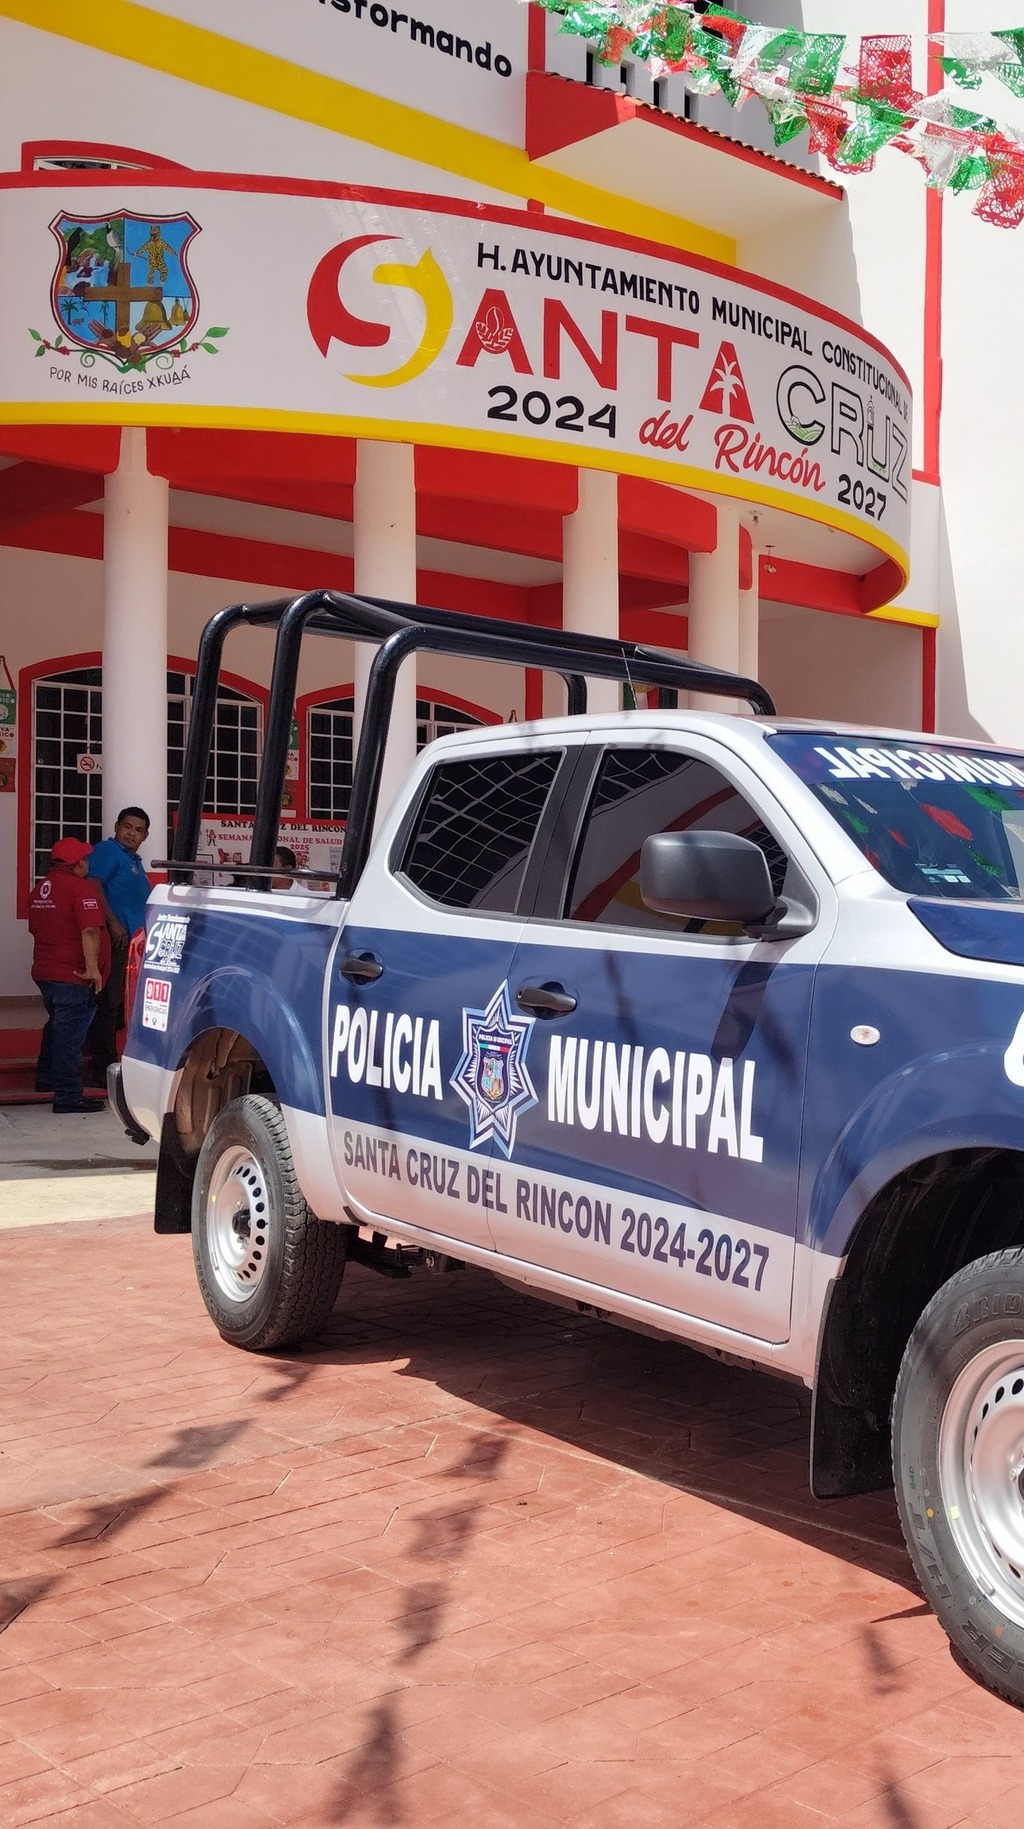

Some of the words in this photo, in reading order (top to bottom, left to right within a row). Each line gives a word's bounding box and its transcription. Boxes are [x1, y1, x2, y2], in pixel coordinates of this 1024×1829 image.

[319, 0, 512, 77] sformando
[511, 248, 700, 314] AYUNTAMIENTO
[711, 297, 813, 356] MUNICIPAL
[821, 340, 903, 417] CONSTITUCIONAL
[49, 366, 71, 382] POR
[77, 373, 97, 389] MIS
[102, 379, 144, 395] RAÍCES
[306, 234, 754, 424] SANTA
[776, 364, 909, 504] CRUZ
[487, 385, 616, 439] 2024
[639, 410, 694, 451] del
[714, 423, 826, 491] Rincón
[837, 474, 886, 521] 2027
[290, 824, 308, 832] DEL
[312, 825, 347, 834] RINCON
[290, 843, 309, 851] 2025
[315, 838, 343, 846] SALUD
[146, 981, 169, 1002] 911
[478, 1033, 493, 1043] POLICIA
[331, 1004, 443, 1101] POLICIA
[548, 1034, 764, 1164] MUNICIPAL
[343, 1130, 401, 1181] SANTA
[406, 1148, 460, 1200] CRUZ
[466, 1164, 508, 1214] DEL
[516, 1178, 611, 1246] RINCON
[620, 1207, 770, 1292] 2024-2027
